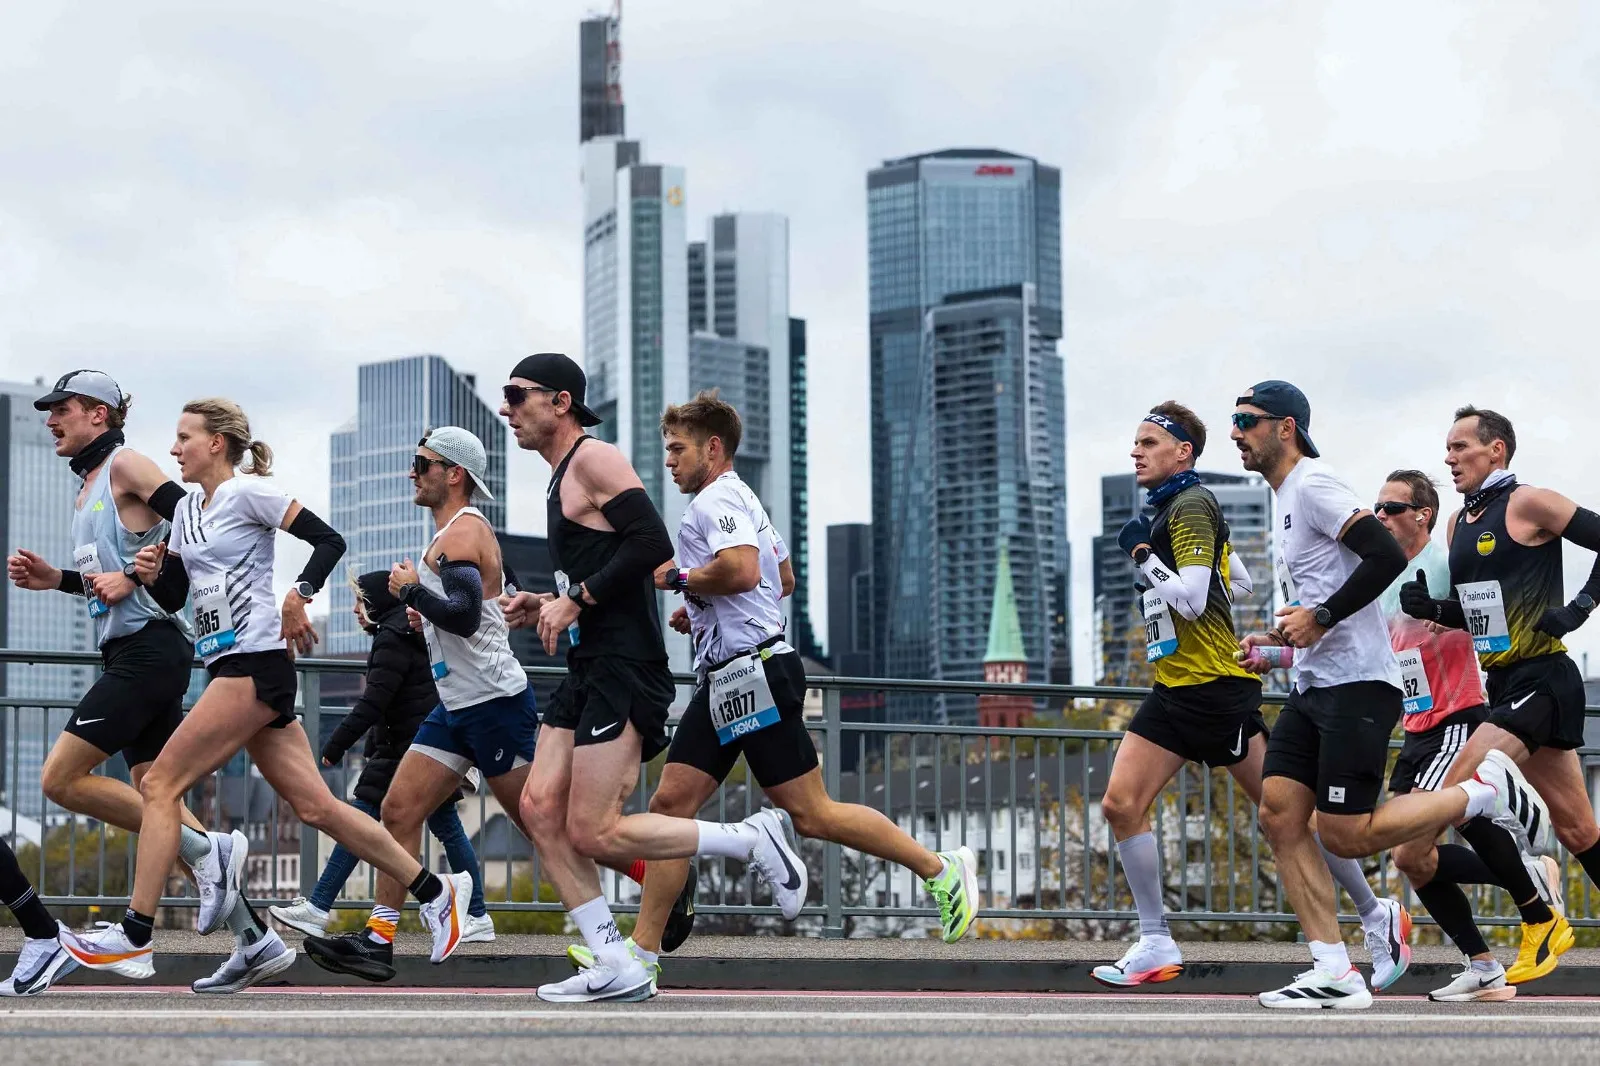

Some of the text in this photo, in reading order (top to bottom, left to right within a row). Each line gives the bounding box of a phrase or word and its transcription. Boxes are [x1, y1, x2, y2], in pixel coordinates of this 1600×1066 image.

[1466, 589, 1496, 602] mainova
[1468, 614, 1490, 637] 2667
[715, 665, 756, 688] mainova
[1403, 677, 1420, 699] 52
[718, 689, 756, 724] 13077
[730, 716, 761, 738] HOKA
